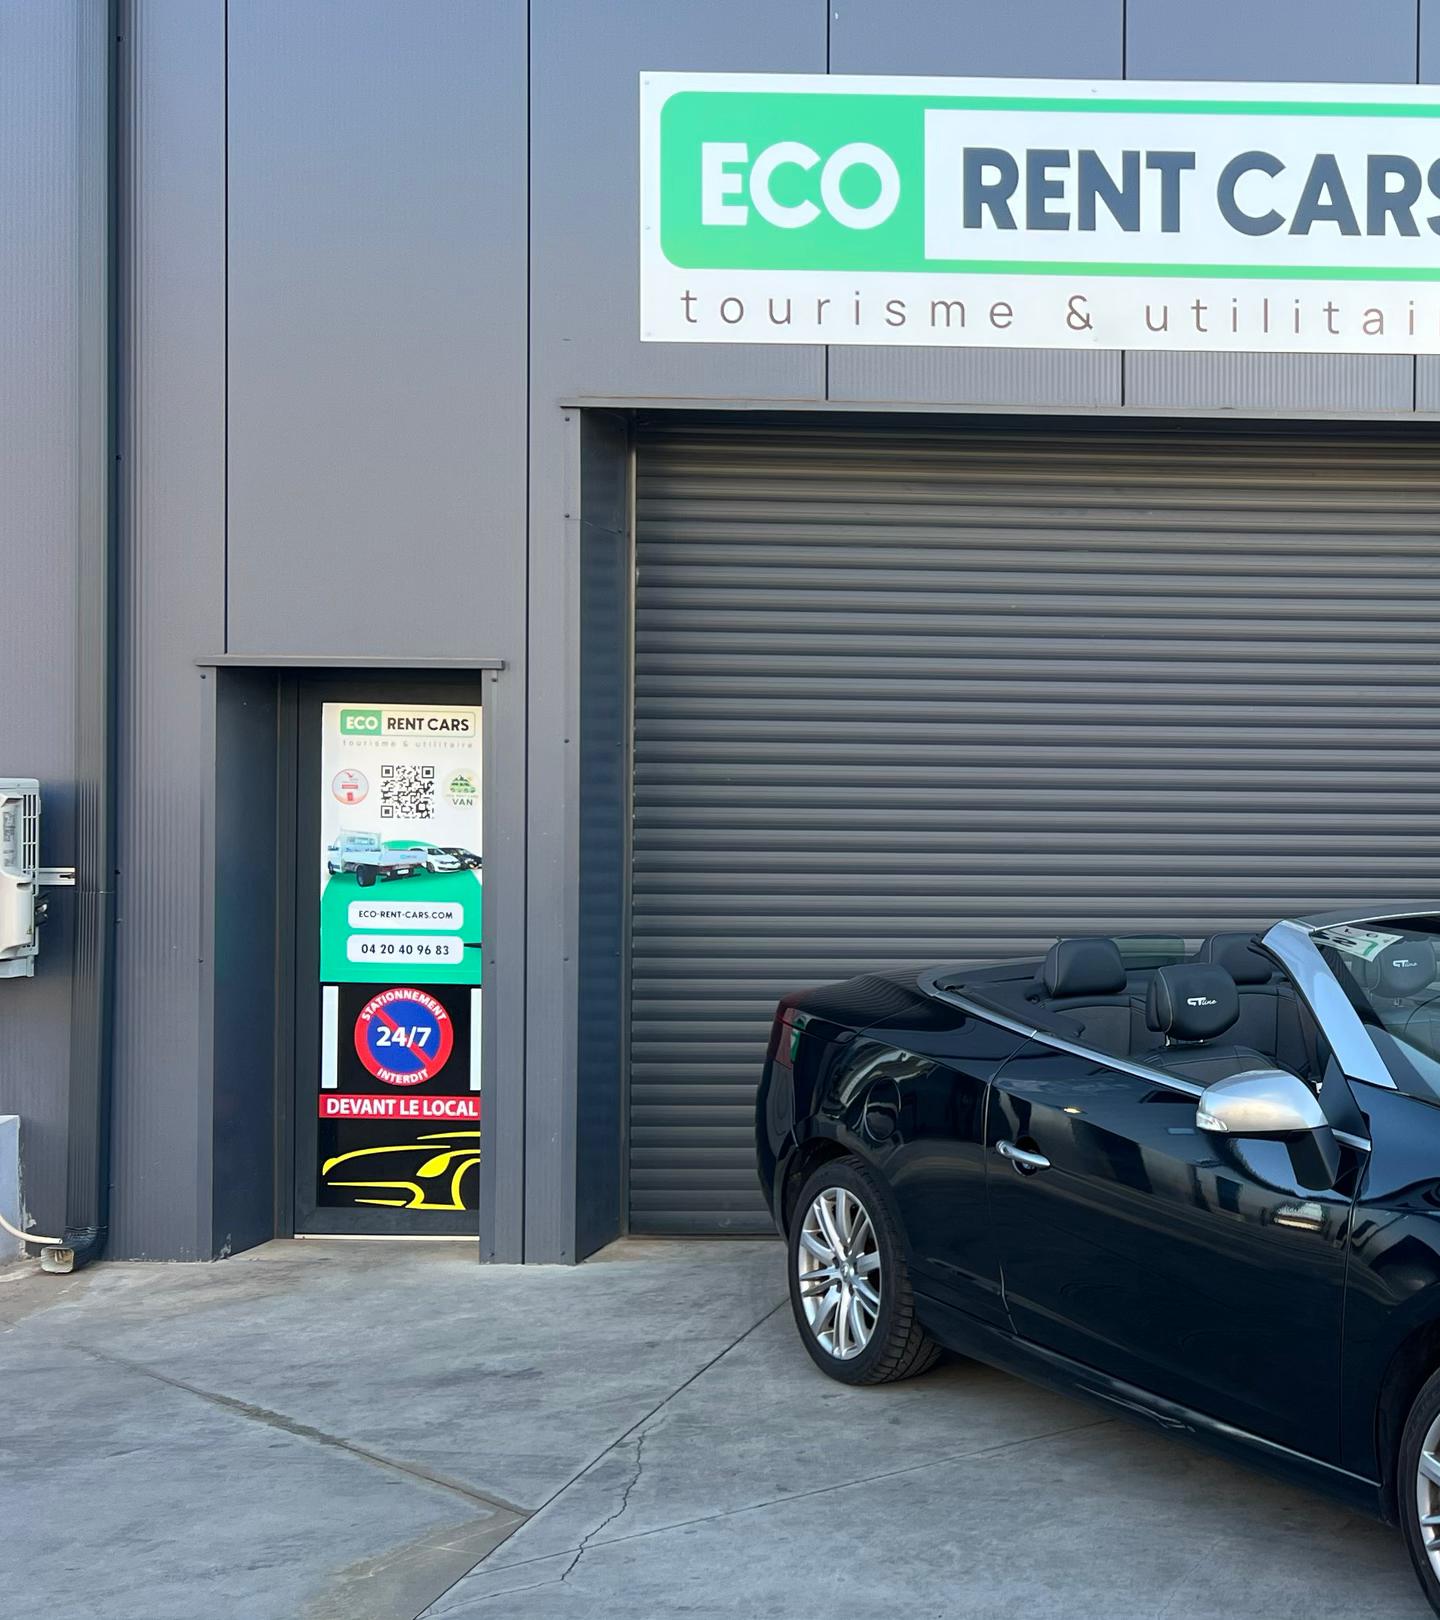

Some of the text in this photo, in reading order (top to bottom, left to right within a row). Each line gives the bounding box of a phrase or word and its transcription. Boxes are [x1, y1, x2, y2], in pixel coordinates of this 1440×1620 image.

[700, 141, 901, 229] ECO
[962, 147, 1196, 232] RENT
[680, 288, 1015, 328] tourisme
[1065, 297, 1094, 331] &
[345, 716, 469, 731] ECO RENT CARS
[342, 739, 396, 747] tourisme
[452, 798, 473, 806] VAN
[358, 910, 453, 920] ECO-RENT-CARS.COM
[361, 943, 449, 956] 04 20 40 96 83
[361, 990, 446, 1021] STATIONNEMENT
[376, 1026, 432, 1048] 24/7
[376, 1068, 429, 1084] INTERDIT
[327, 1099, 478, 1117] DEVANT LE LOCAL
